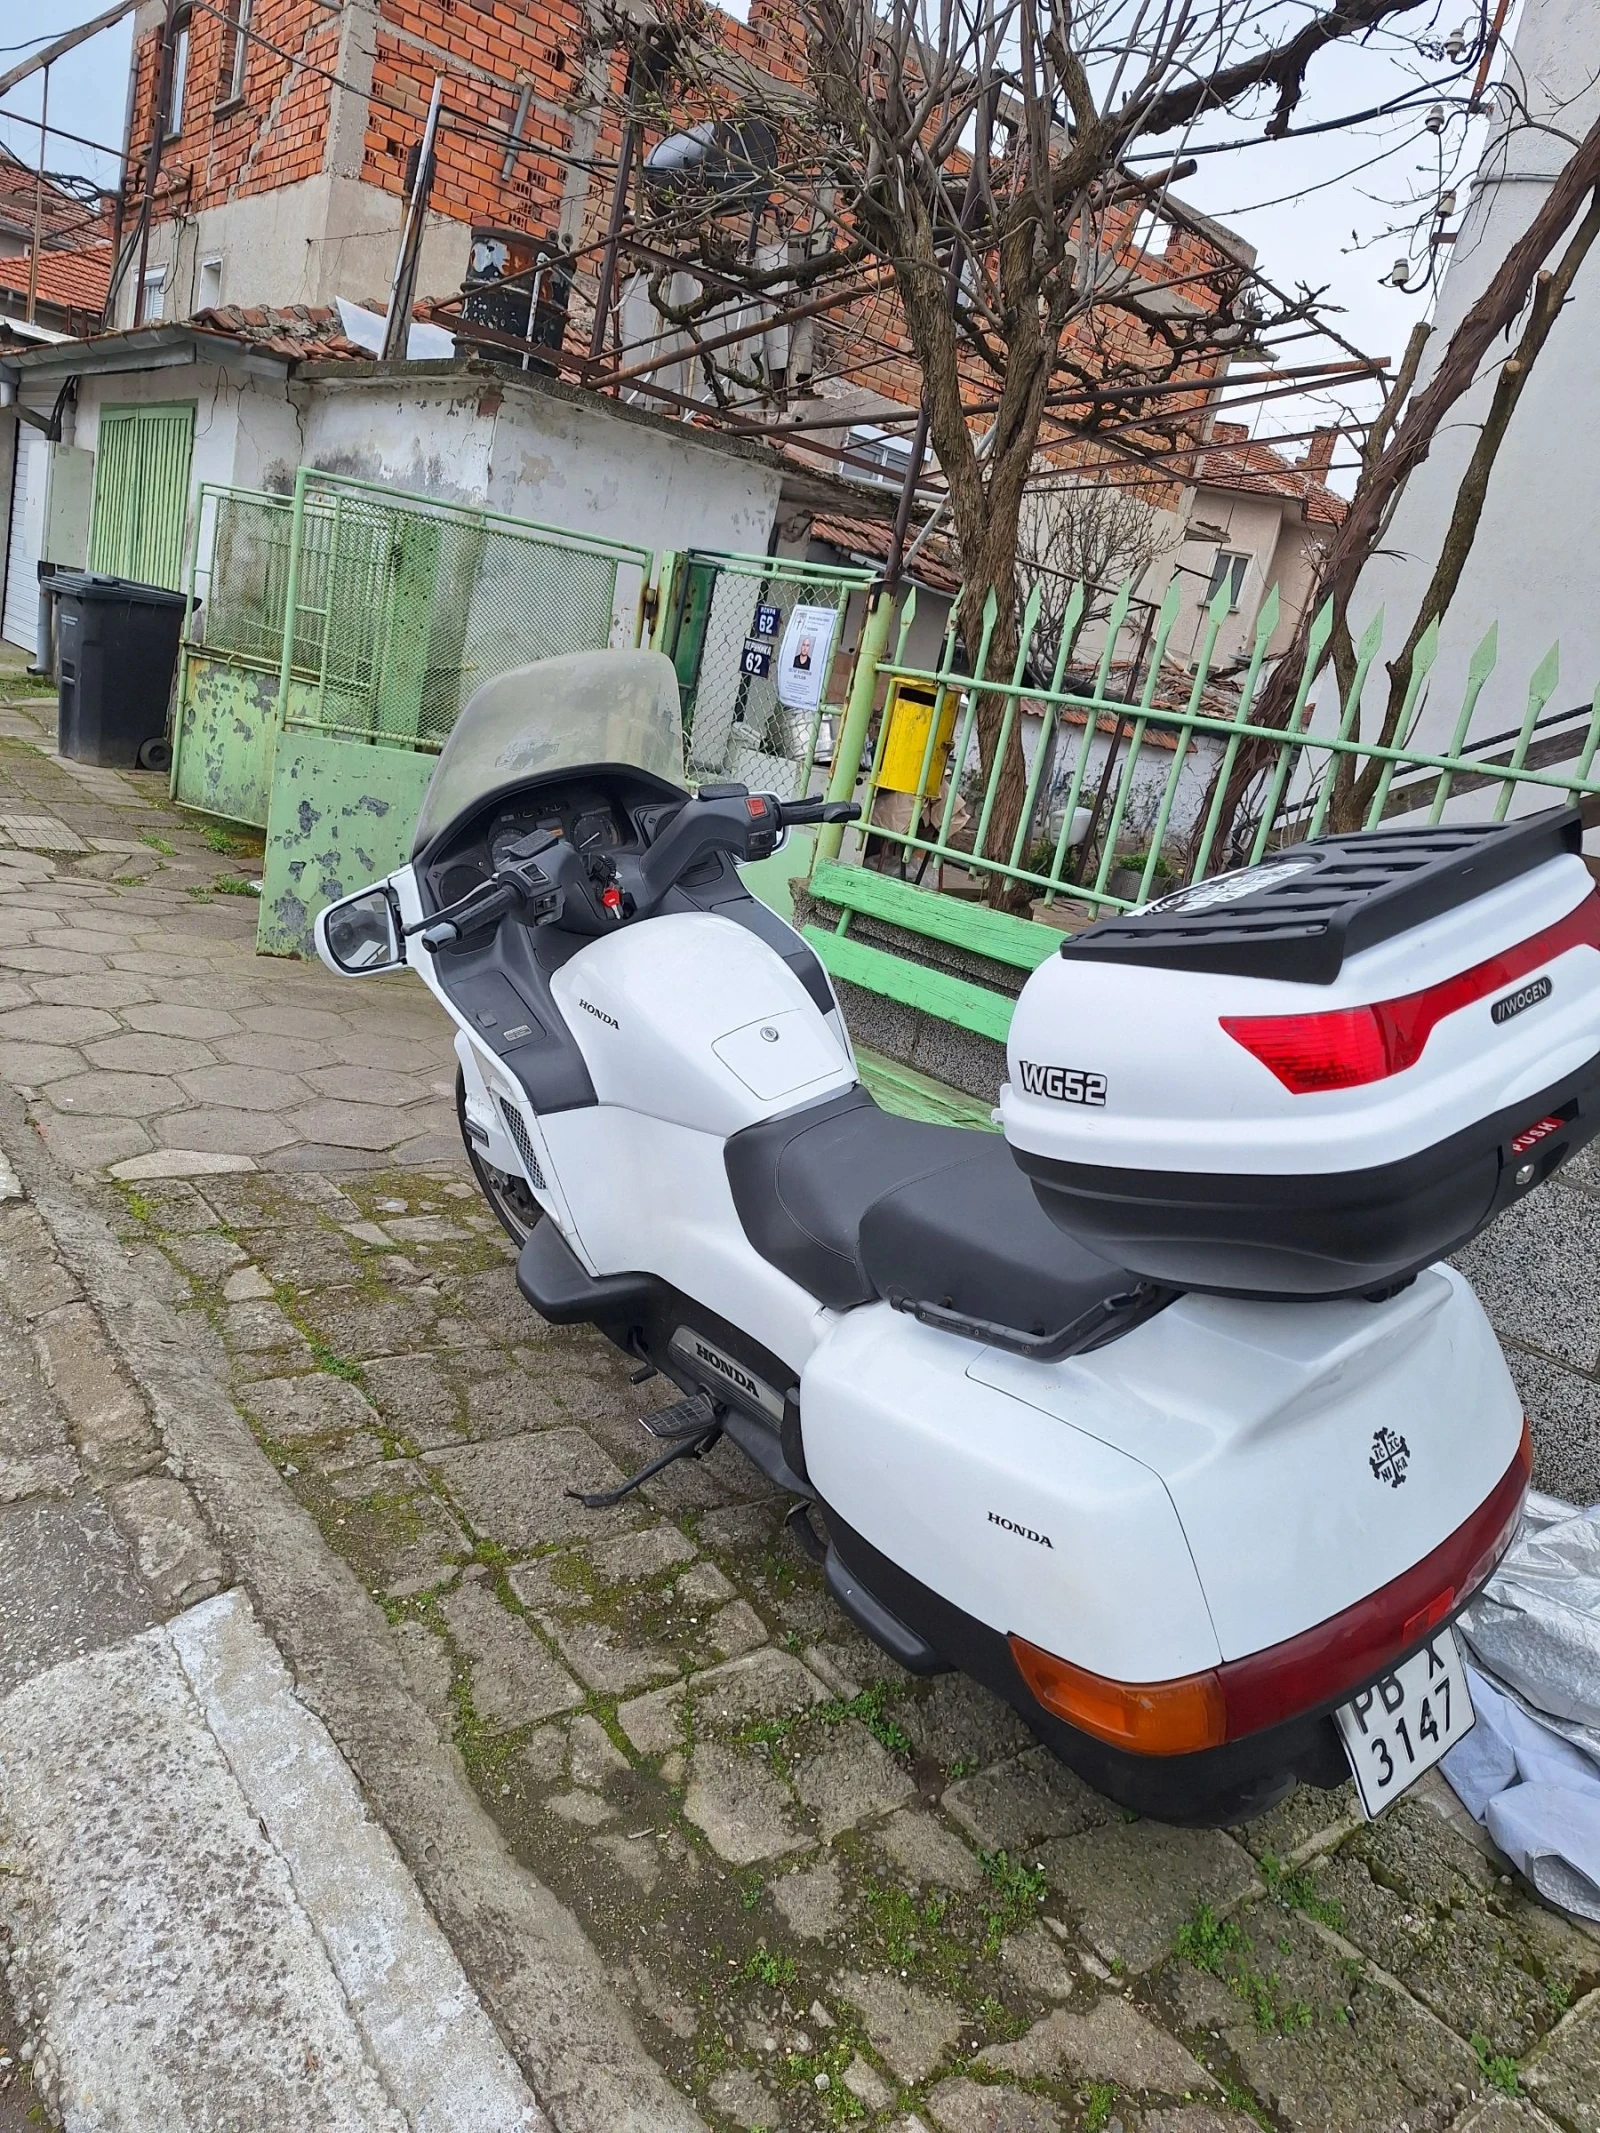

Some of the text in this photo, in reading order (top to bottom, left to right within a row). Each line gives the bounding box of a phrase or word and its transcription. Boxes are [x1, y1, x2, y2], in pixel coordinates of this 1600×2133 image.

[759, 614, 774, 634] 62
[745, 652, 763, 674] 62
[579, 998, 620, 1031] HONDA
[1019, 1060, 1107, 1107] WG52
[1512, 1121, 1558, 1152] PUSH
[695, 1342, 760, 1399] HONDA
[987, 1510, 1054, 1549] HONDA
[1371, 1676, 1451, 1787] 3147
